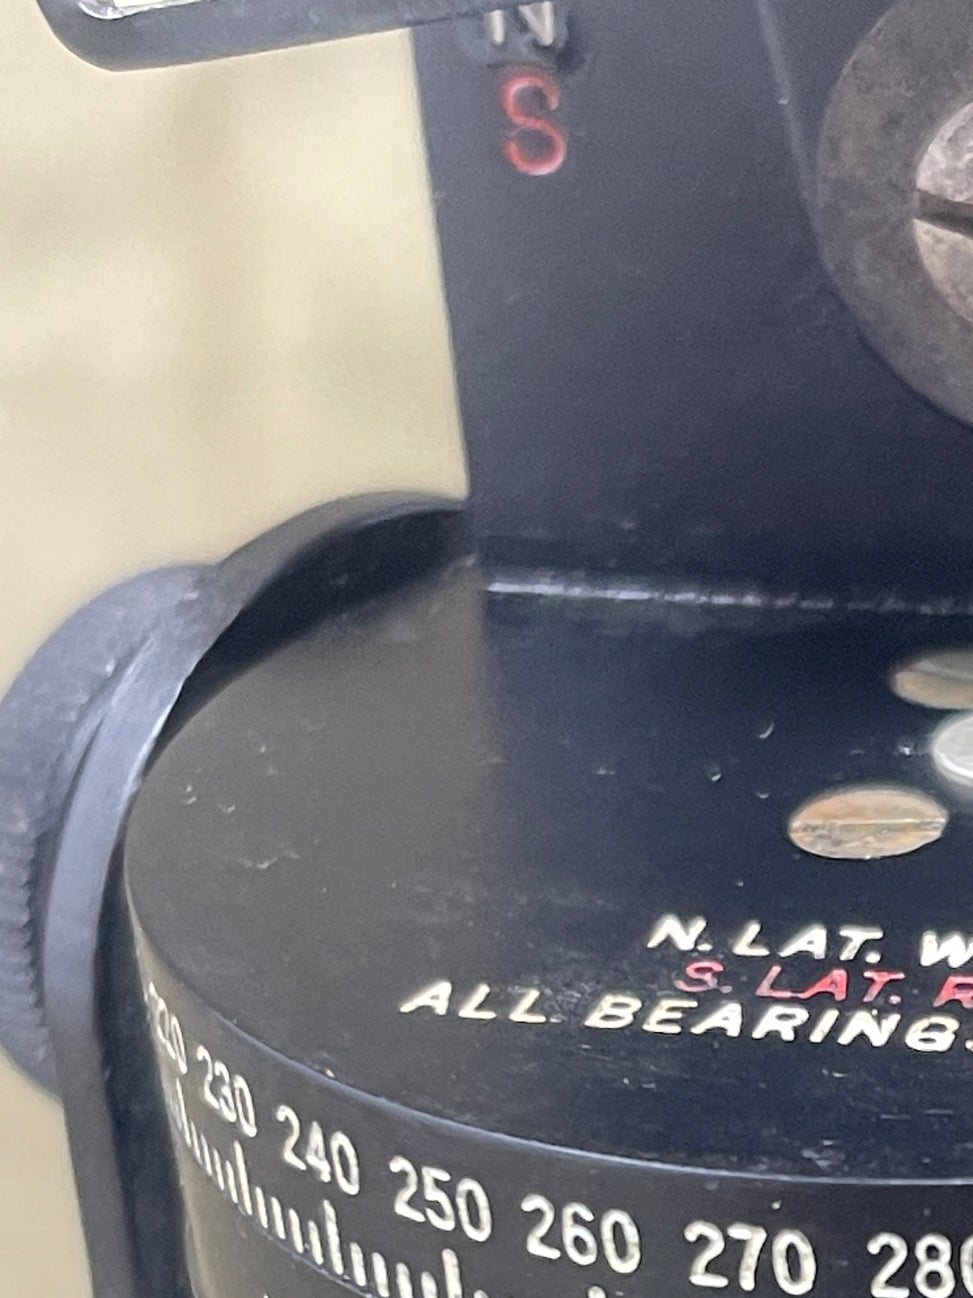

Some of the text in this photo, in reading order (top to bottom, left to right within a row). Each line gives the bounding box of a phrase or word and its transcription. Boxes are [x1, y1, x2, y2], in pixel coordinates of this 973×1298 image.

[501, 72, 567, 176] S
[196, 1044, 258, 1138] 230
[276, 1103, 361, 1197] 240
[389, 1154, 493, 1243] 250
[520, 1193, 642, 1275] 260
[683, 1219, 817, 1296] 270
